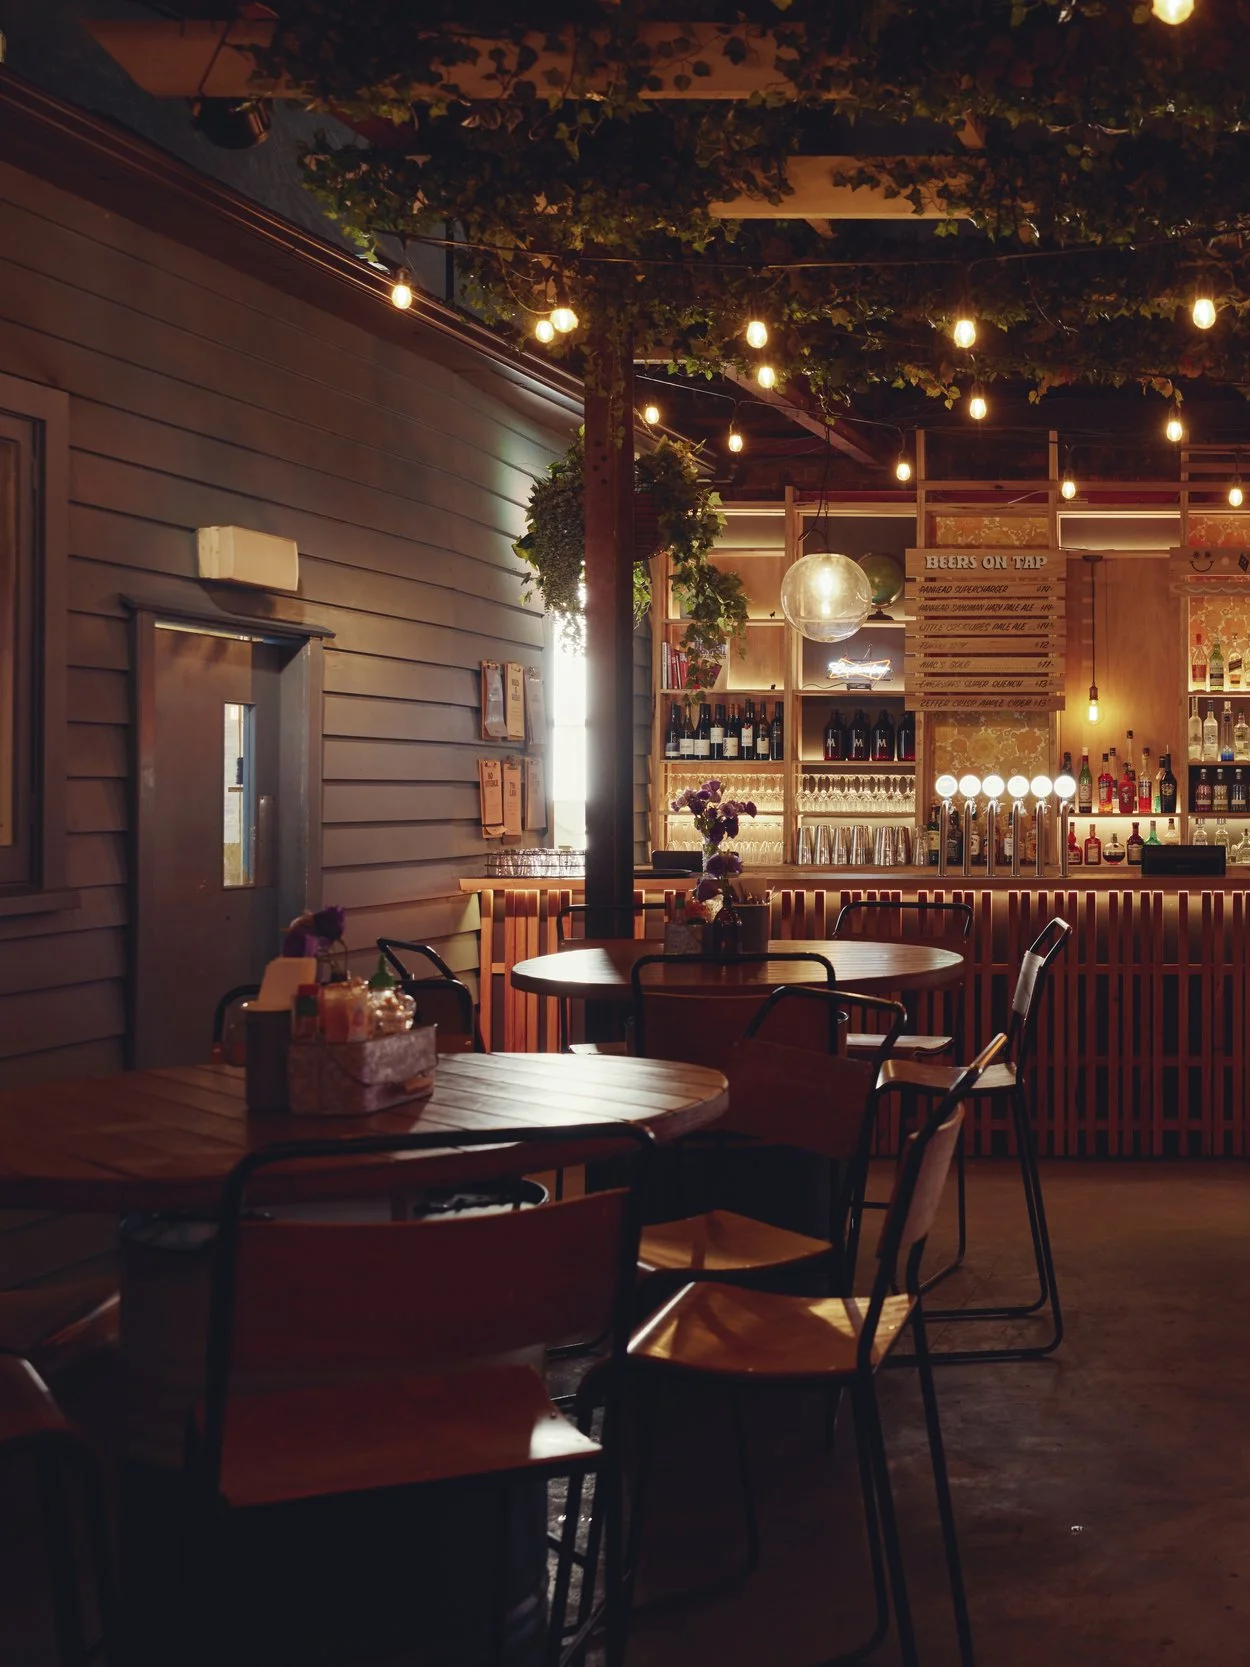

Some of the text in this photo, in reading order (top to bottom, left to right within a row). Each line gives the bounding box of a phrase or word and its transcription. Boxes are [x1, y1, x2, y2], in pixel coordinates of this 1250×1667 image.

[925, 556, 1048, 570] BEERS ON TAP
[919, 585, 952, 594] PANHEAD
[954, 585, 1009, 594] SUPERCHARGER
[1003, 603, 1021, 612] PALE
[1022, 603, 1034, 612] ALE
[992, 623, 1012, 631] PALE
[1012, 623, 1026, 631] ALE
[992, 680, 1024, 689] QUENCH
